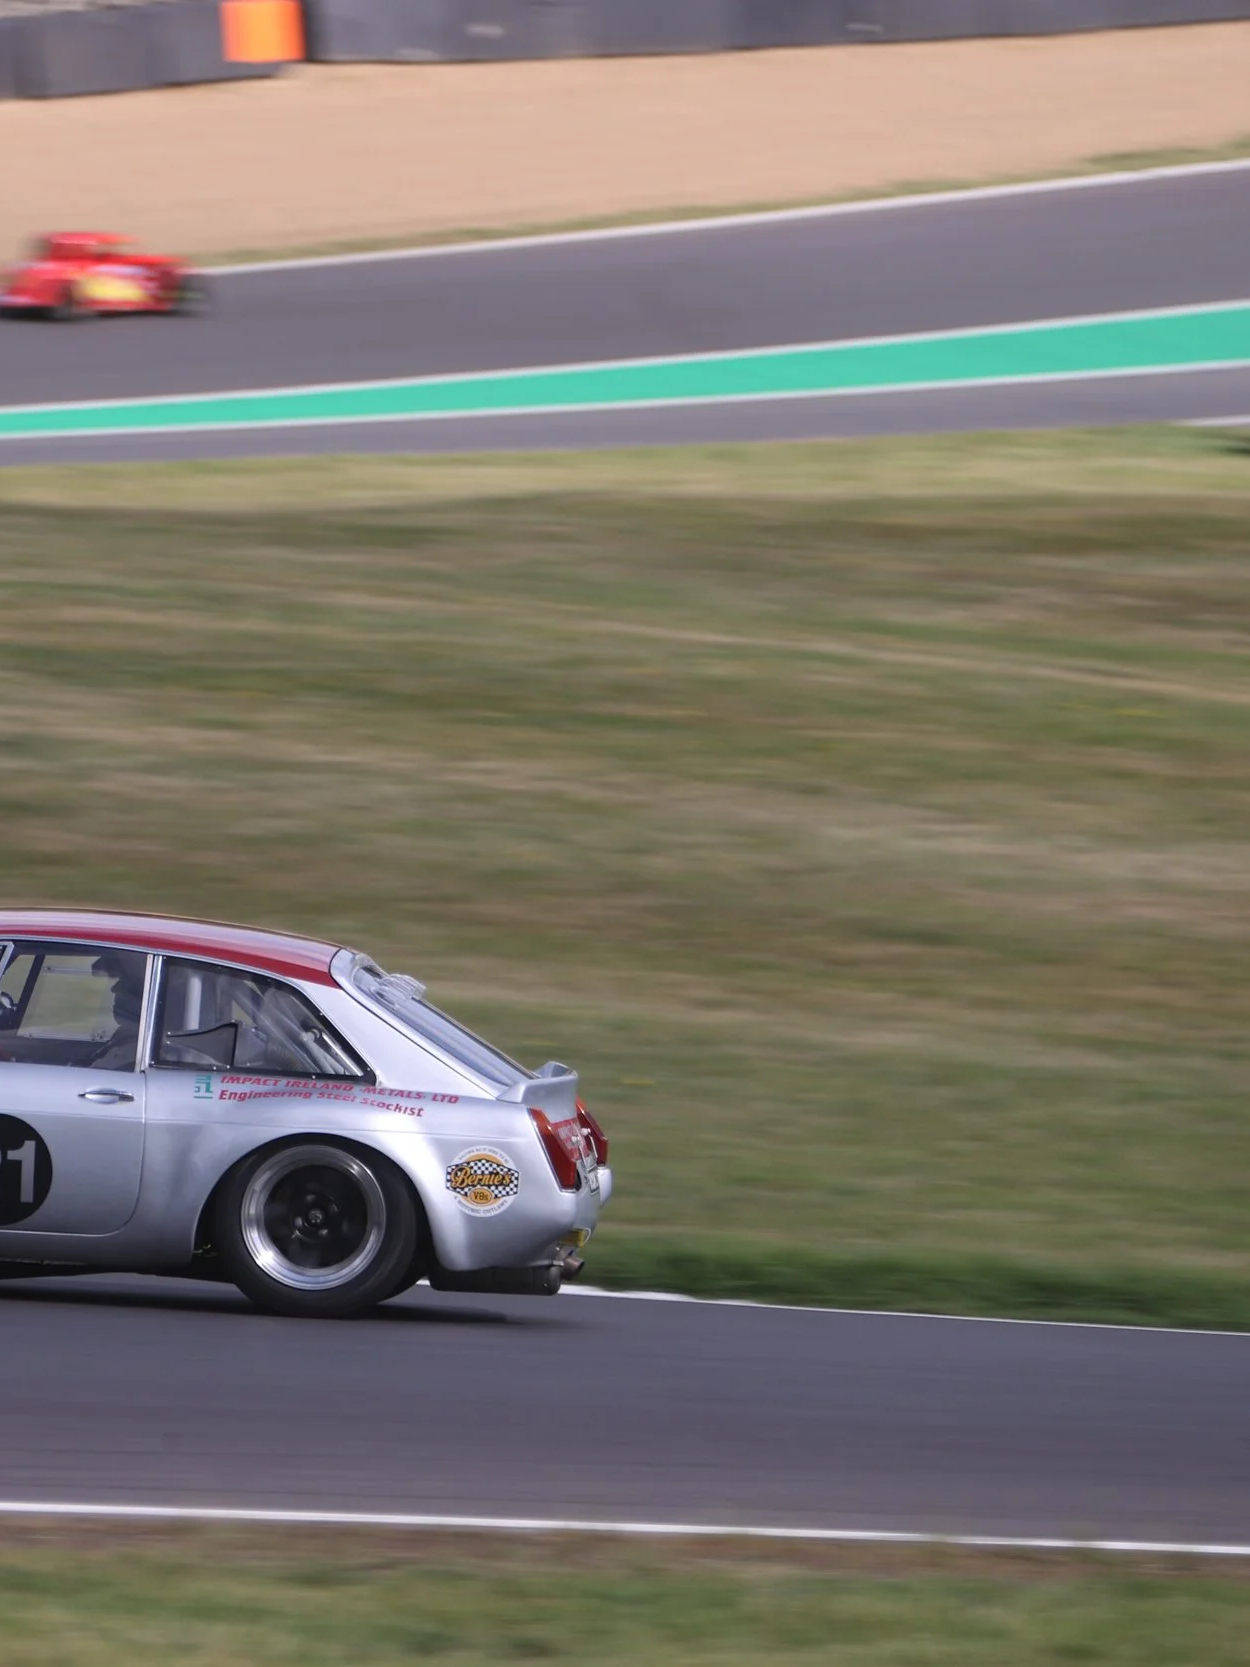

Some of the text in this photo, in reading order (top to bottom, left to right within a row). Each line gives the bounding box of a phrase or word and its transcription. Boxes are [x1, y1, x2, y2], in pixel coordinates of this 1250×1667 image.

[218, 1090, 425, 1117] Engineering Steel Stockist
[220, 1076, 281, 1087] IMPACT
[285, 1080, 354, 1092] IRELAND
[431, 1093, 459, 1104] LTD
[451, 1166, 511, 1188] Bernie's
